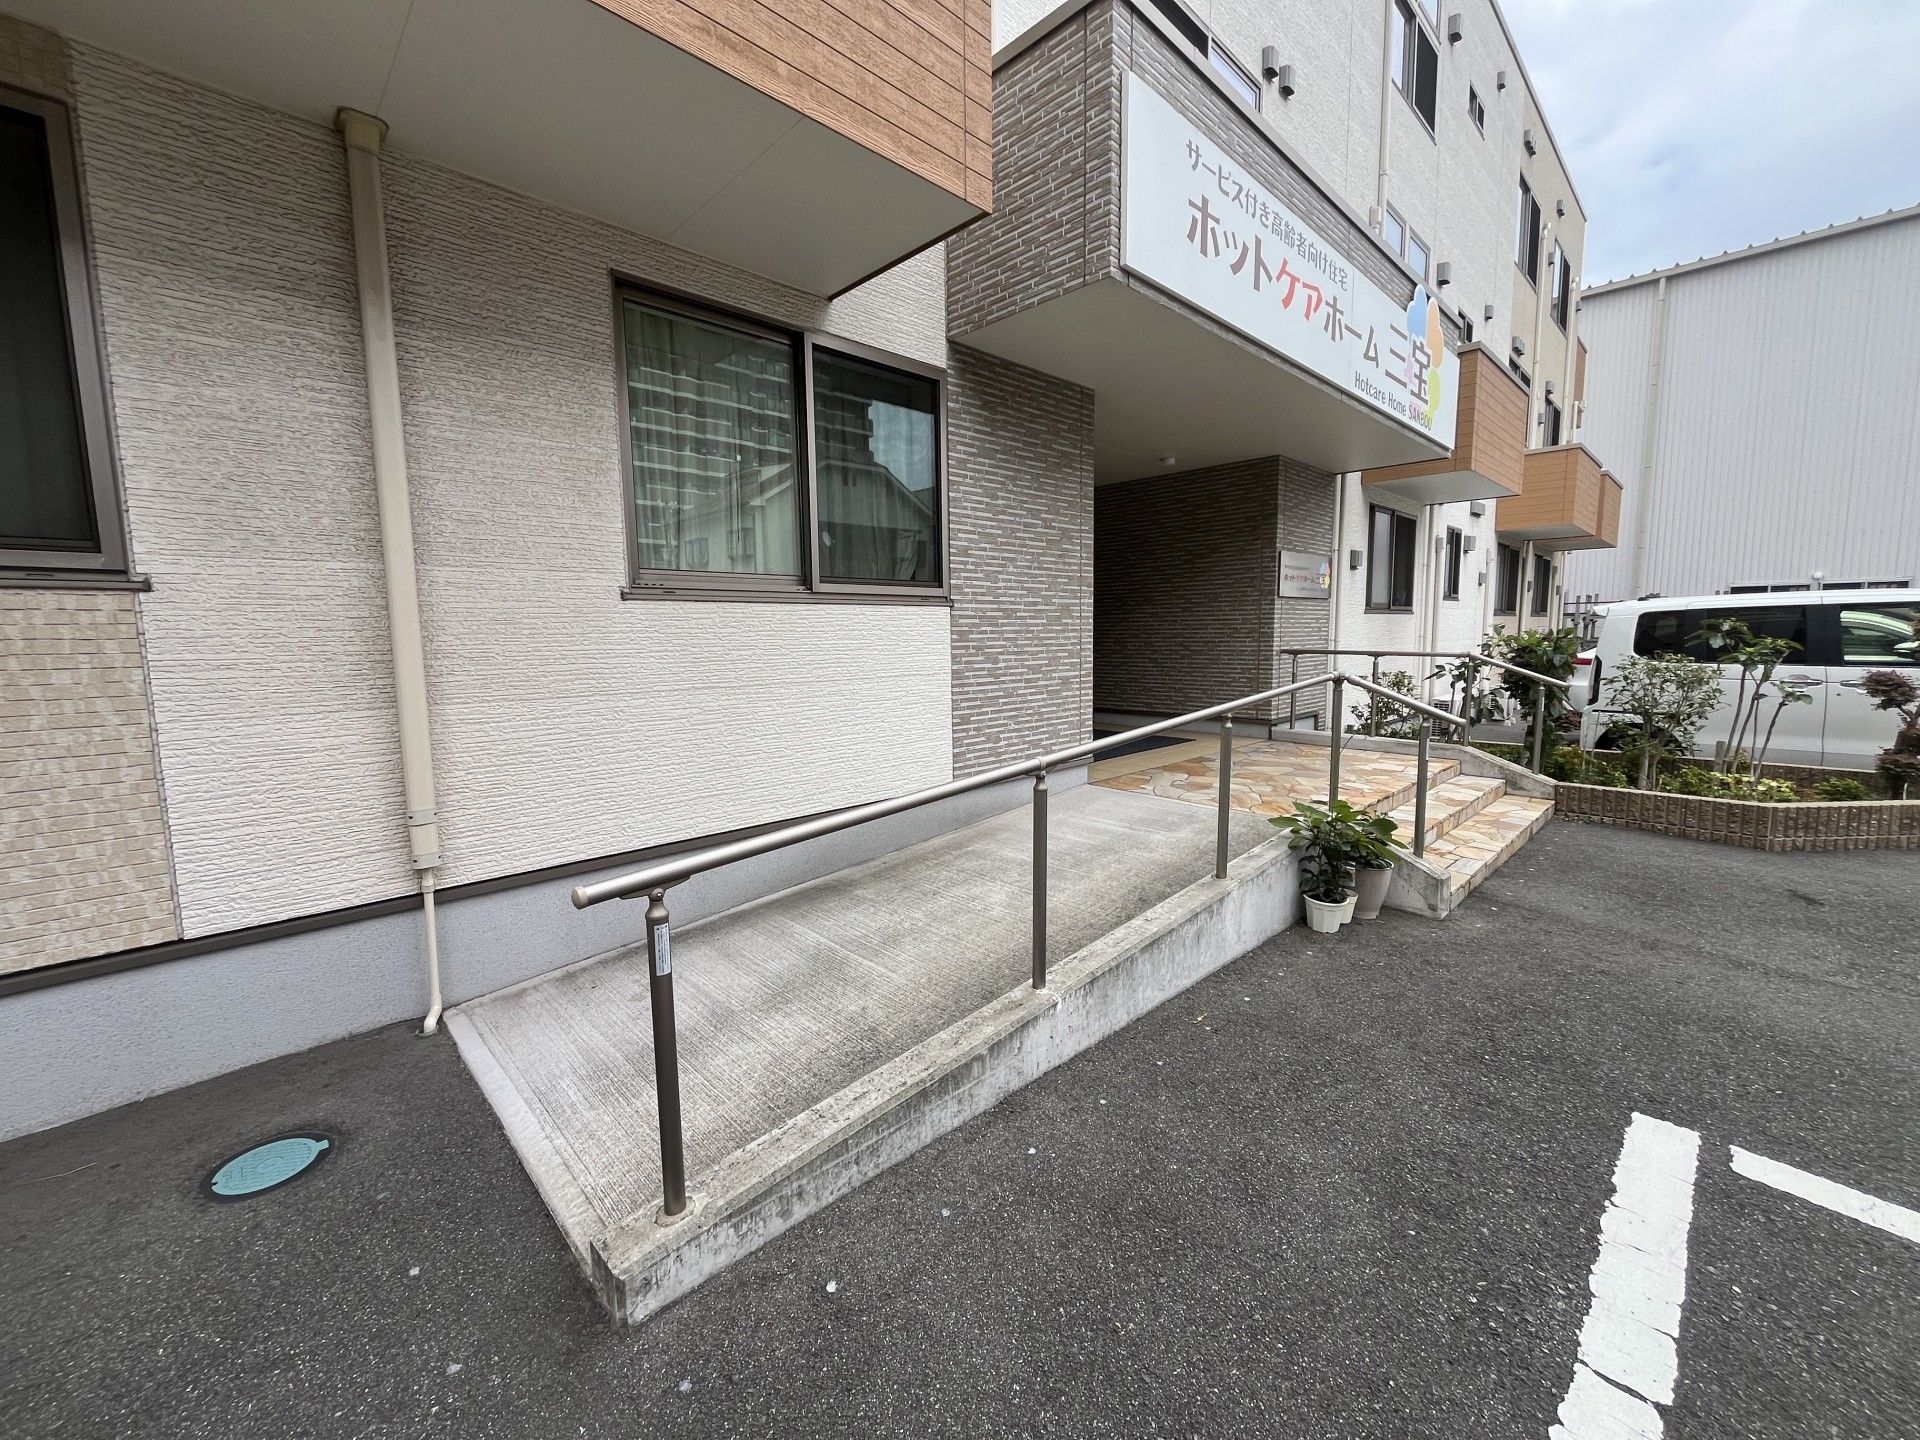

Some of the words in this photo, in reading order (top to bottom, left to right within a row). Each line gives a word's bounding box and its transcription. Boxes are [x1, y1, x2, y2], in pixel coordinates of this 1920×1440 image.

[1185, 139, 1349, 292] サービス付き高齢者向け住宅
[1354, 371, 1386, 403] Hotcare
[1387, 391, 1407, 416] Home
